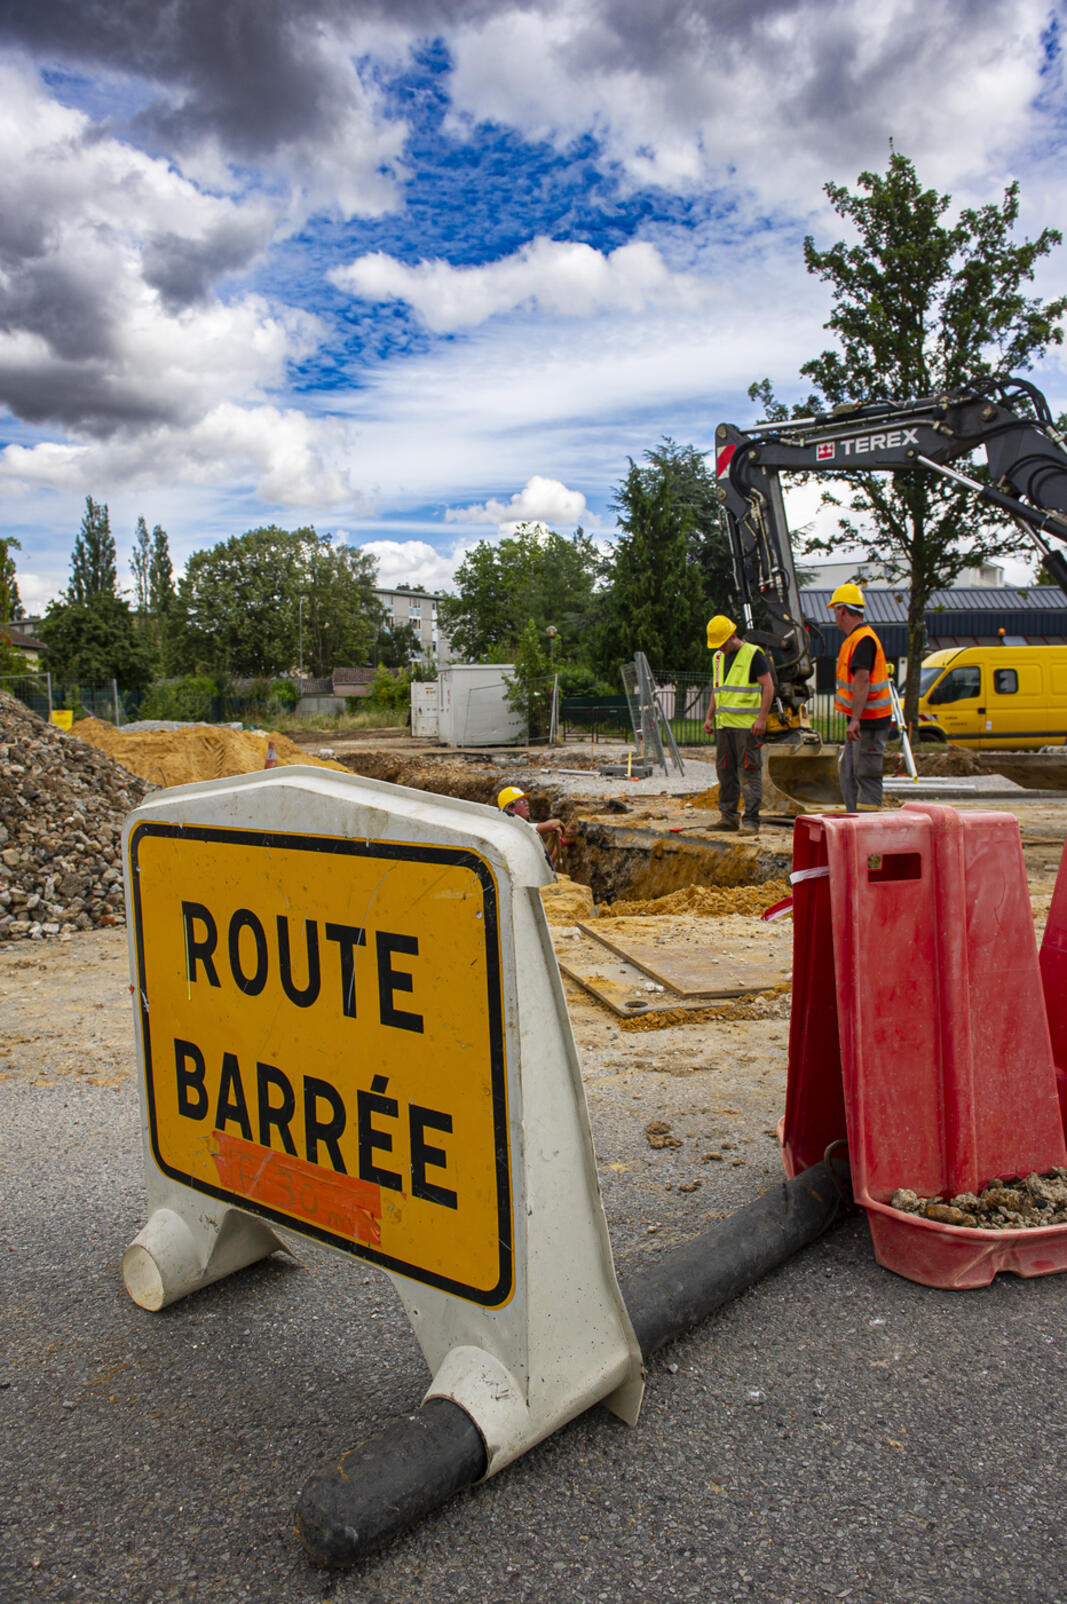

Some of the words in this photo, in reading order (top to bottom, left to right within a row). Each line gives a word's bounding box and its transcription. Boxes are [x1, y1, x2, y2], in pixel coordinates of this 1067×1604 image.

[841, 428, 919, 455] TEREX
[182, 901, 424, 1034] ROUTE
[174, 1038, 457, 1210] BARRÉE
